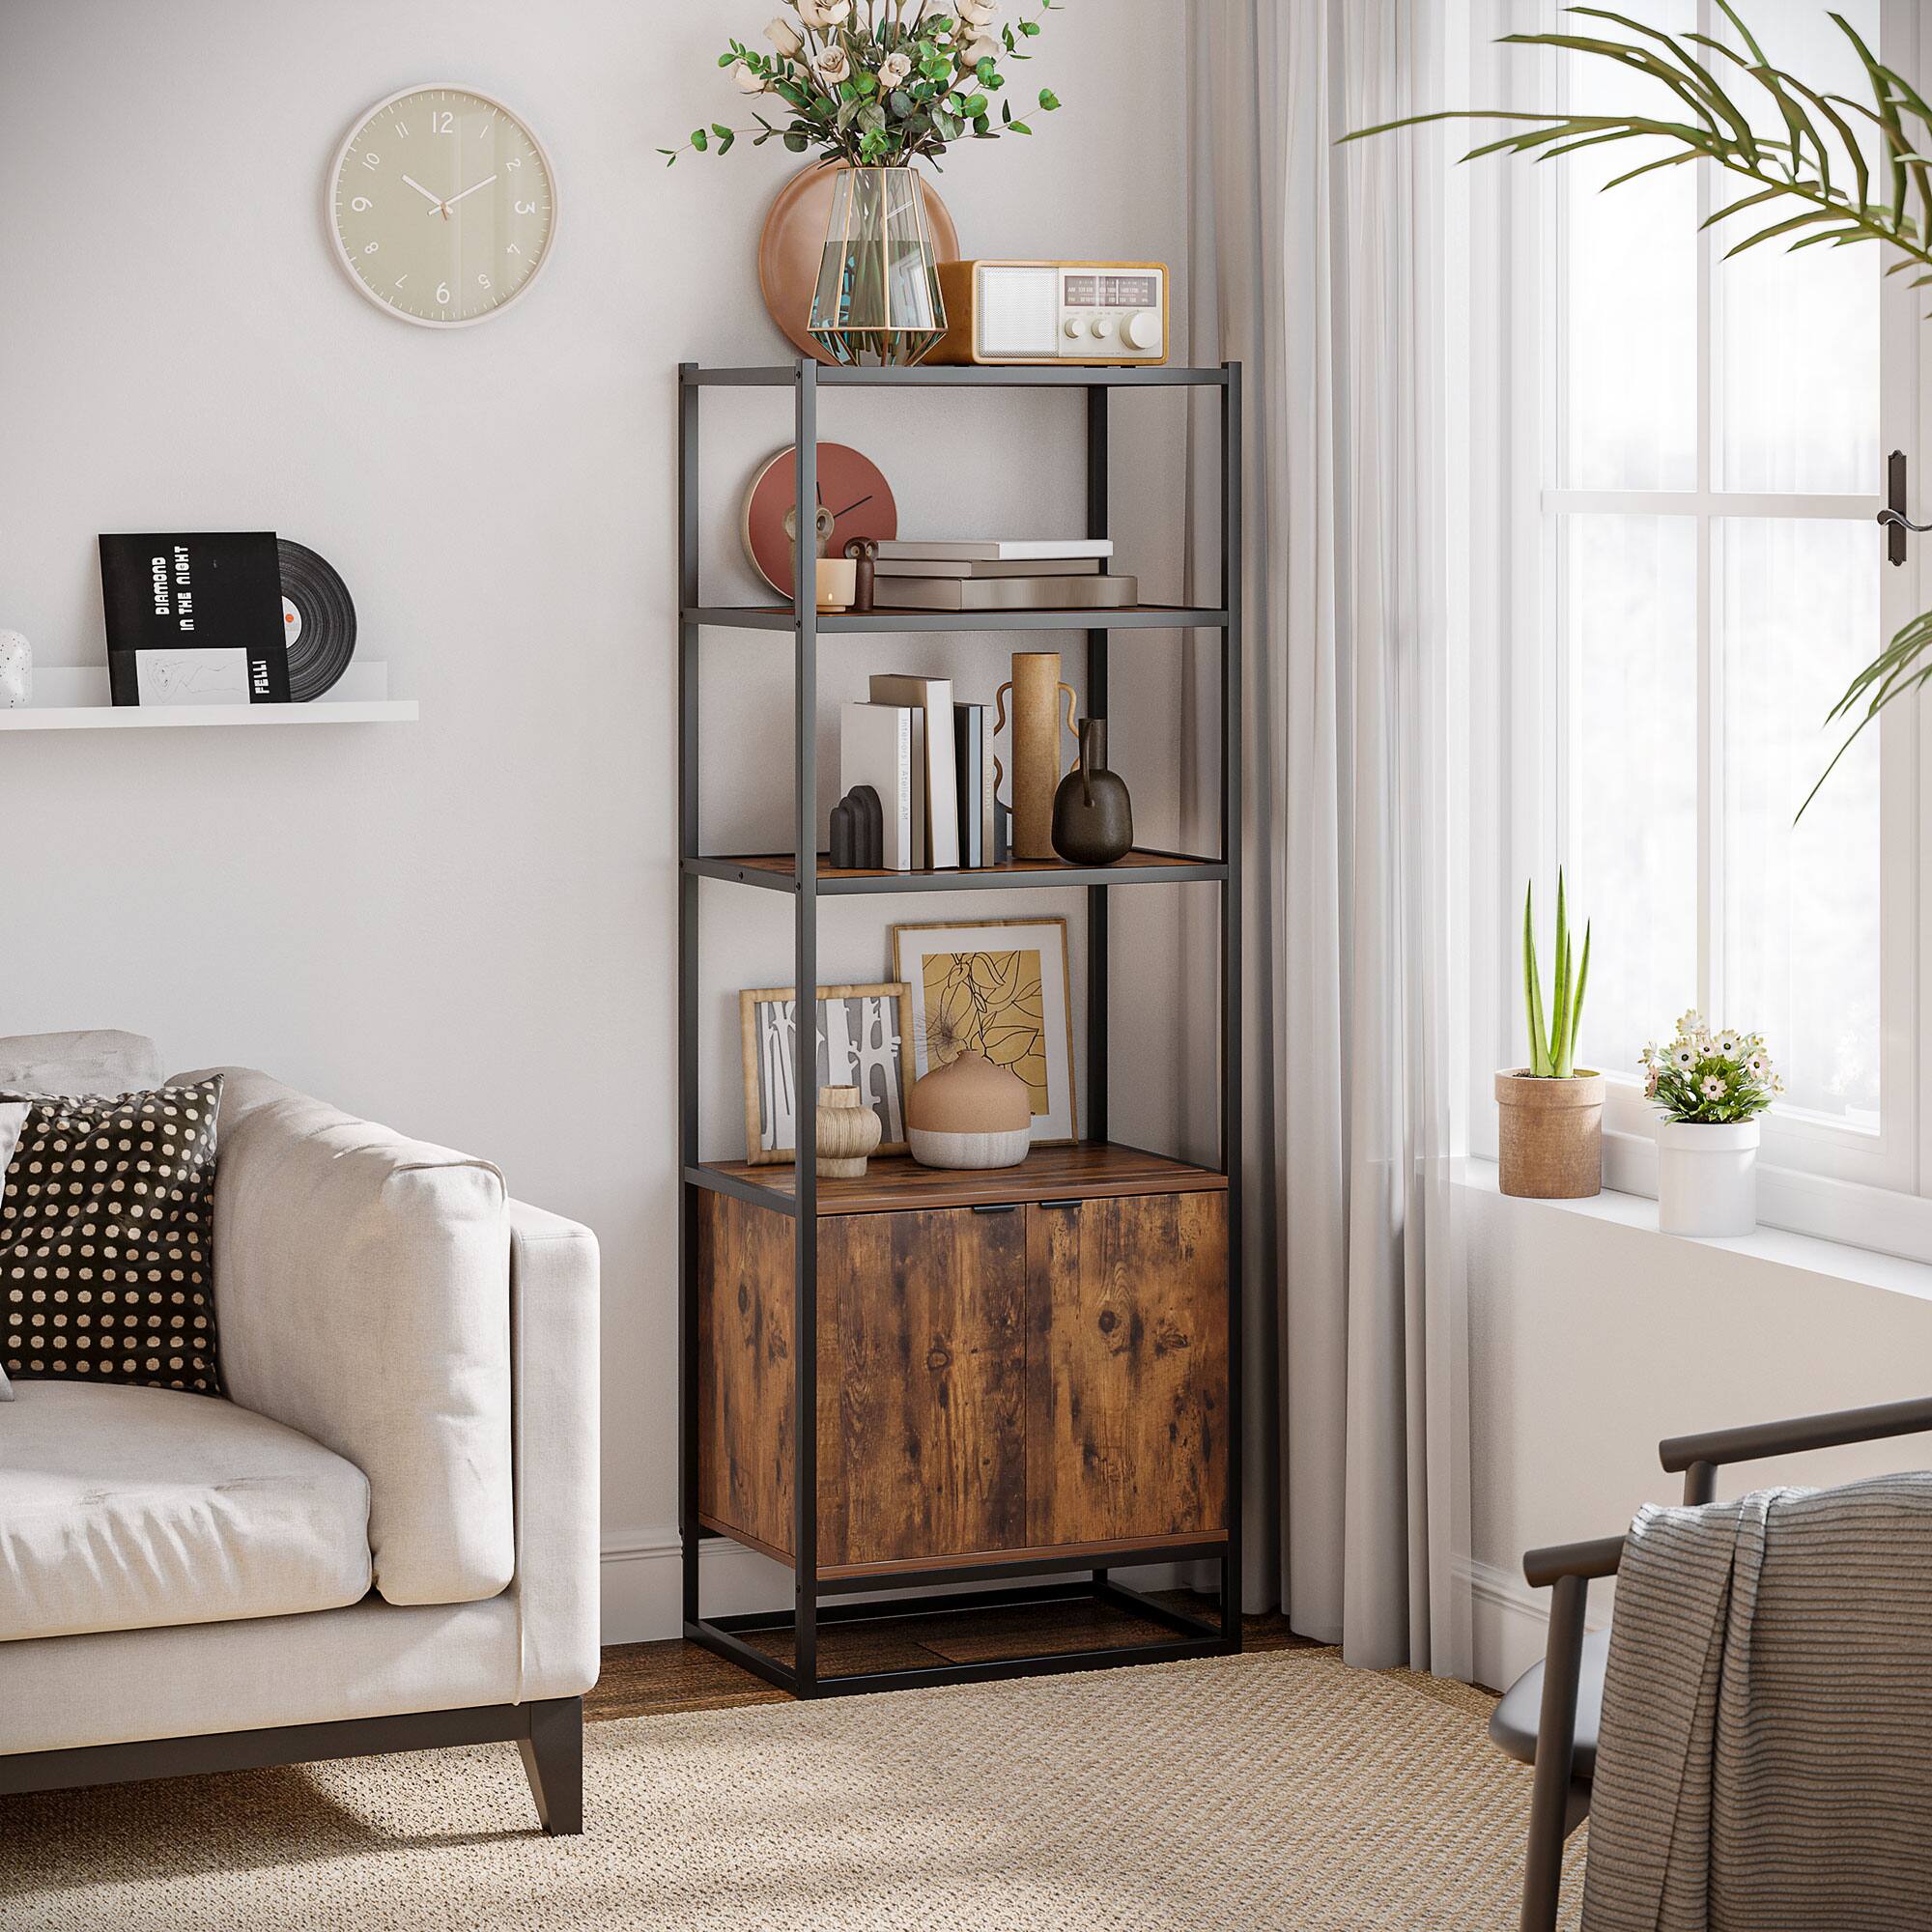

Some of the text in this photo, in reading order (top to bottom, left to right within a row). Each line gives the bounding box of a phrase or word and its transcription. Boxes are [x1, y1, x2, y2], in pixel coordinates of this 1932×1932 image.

[395, 122, 410, 138] 11
[432, 111, 454, 133] 12
[479, 125, 489, 139] 1
[361, 153, 381, 171] 10
[505, 157, 521, 172] 2
[351, 196, 373, 213] 9
[514, 200, 536, 214] 3
[364, 242, 379, 254] 8
[505, 242, 521, 254] 4
[394, 273, 408, 288] 7
[477, 273, 492, 290] 5
[436, 282, 450, 304] 6
[152, 556, 170, 615] DIAMOND
[174, 546, 195, 631] IN THE NIGHT
[252, 660, 270, 695] FELLI
[901, 807, 909, 820] AM
